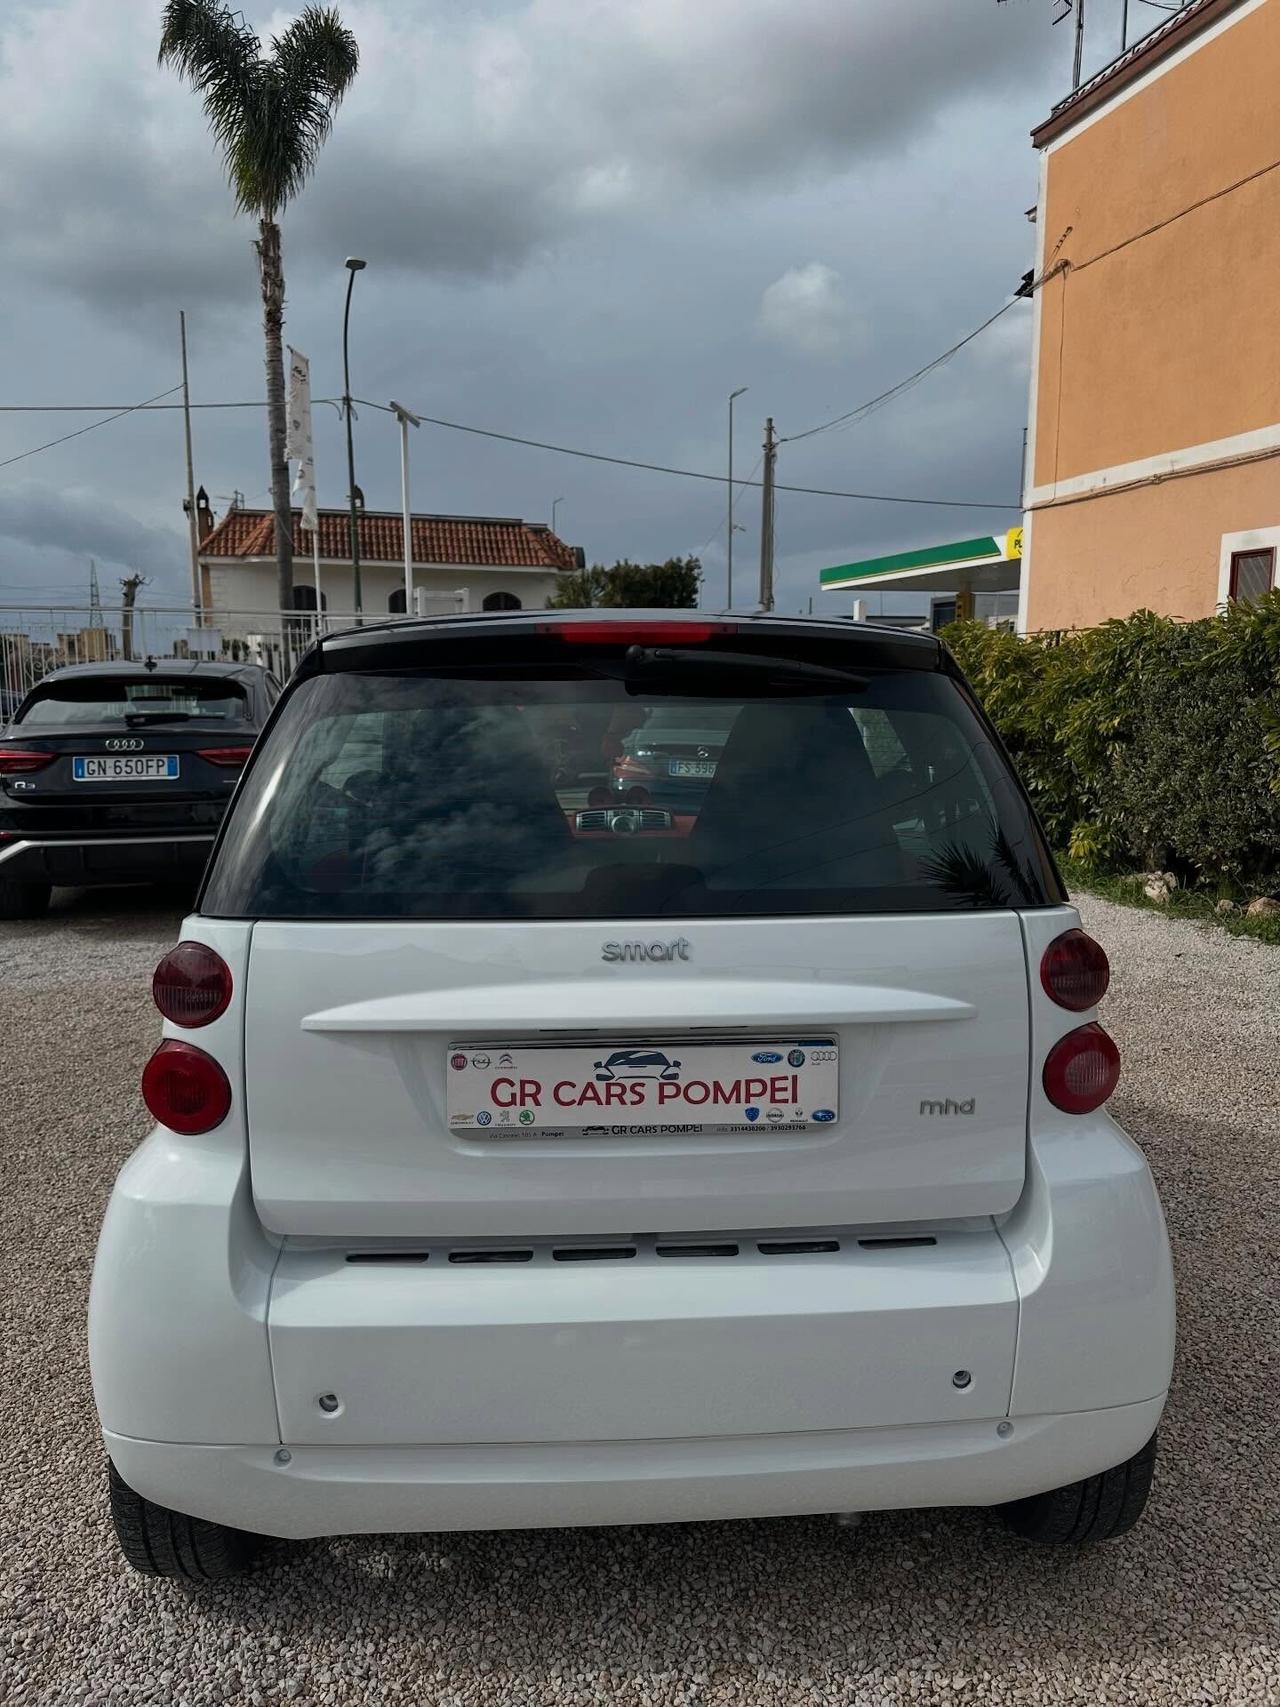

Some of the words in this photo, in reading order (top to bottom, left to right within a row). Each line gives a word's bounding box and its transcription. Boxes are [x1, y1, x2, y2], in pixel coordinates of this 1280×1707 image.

[86, 760, 107, 776] GN
[113, 758, 166, 776] 650FP
[601, 937, 690, 962] smart
[490, 1077, 542, 1107] GR
[553, 1080, 646, 1107] CARS
[658, 1075, 799, 1106] POMPEI
[920, 1098, 976, 1115] mhd
[612, 1125, 628, 1135] GR
[630, 1125, 658, 1135] CARS
[660, 1124, 703, 1134] POMPEI
